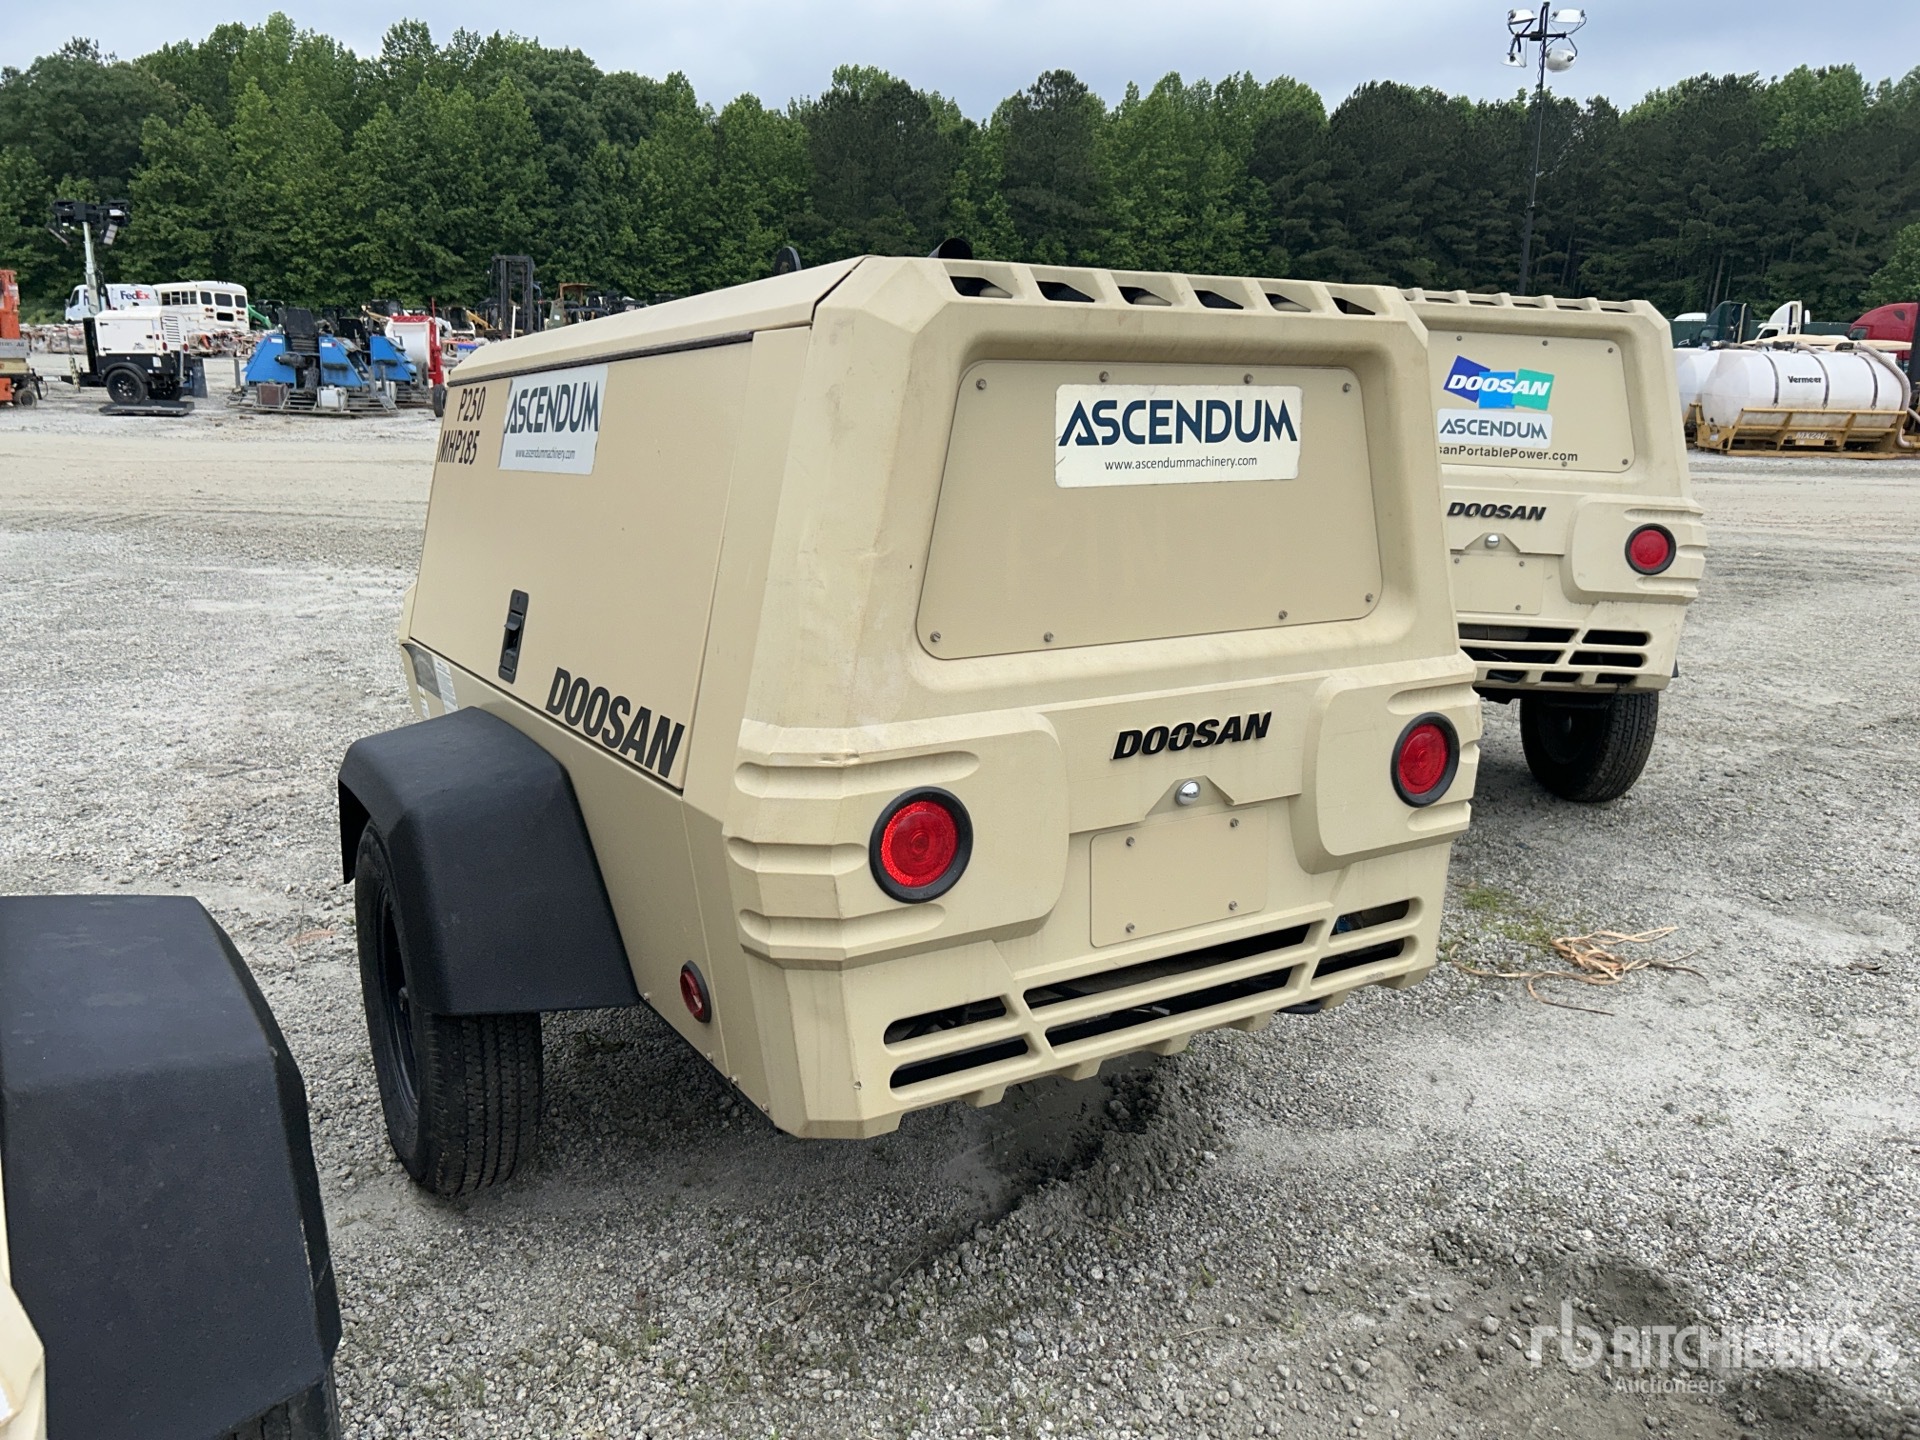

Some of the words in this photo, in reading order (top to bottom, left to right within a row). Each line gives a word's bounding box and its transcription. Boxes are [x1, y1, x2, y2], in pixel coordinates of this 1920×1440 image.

[120, 290, 150, 300] FedEx
[1448, 374, 1551, 396] DOOSAN
[457, 386, 486, 422] P250
[504, 380, 599, 434] ASCENDUM
[1058, 399, 1298, 446] ASCENDUM
[1439, 418, 1548, 440] ASCENDUM
[438, 429, 480, 465] MHP185
[1104, 455, 1257, 471] www.ascendummachinery.com
[1447, 502, 1546, 521] DOOSAN
[545, 666, 686, 779] DOOSAN
[1110, 711, 1272, 760] DOOSAN
